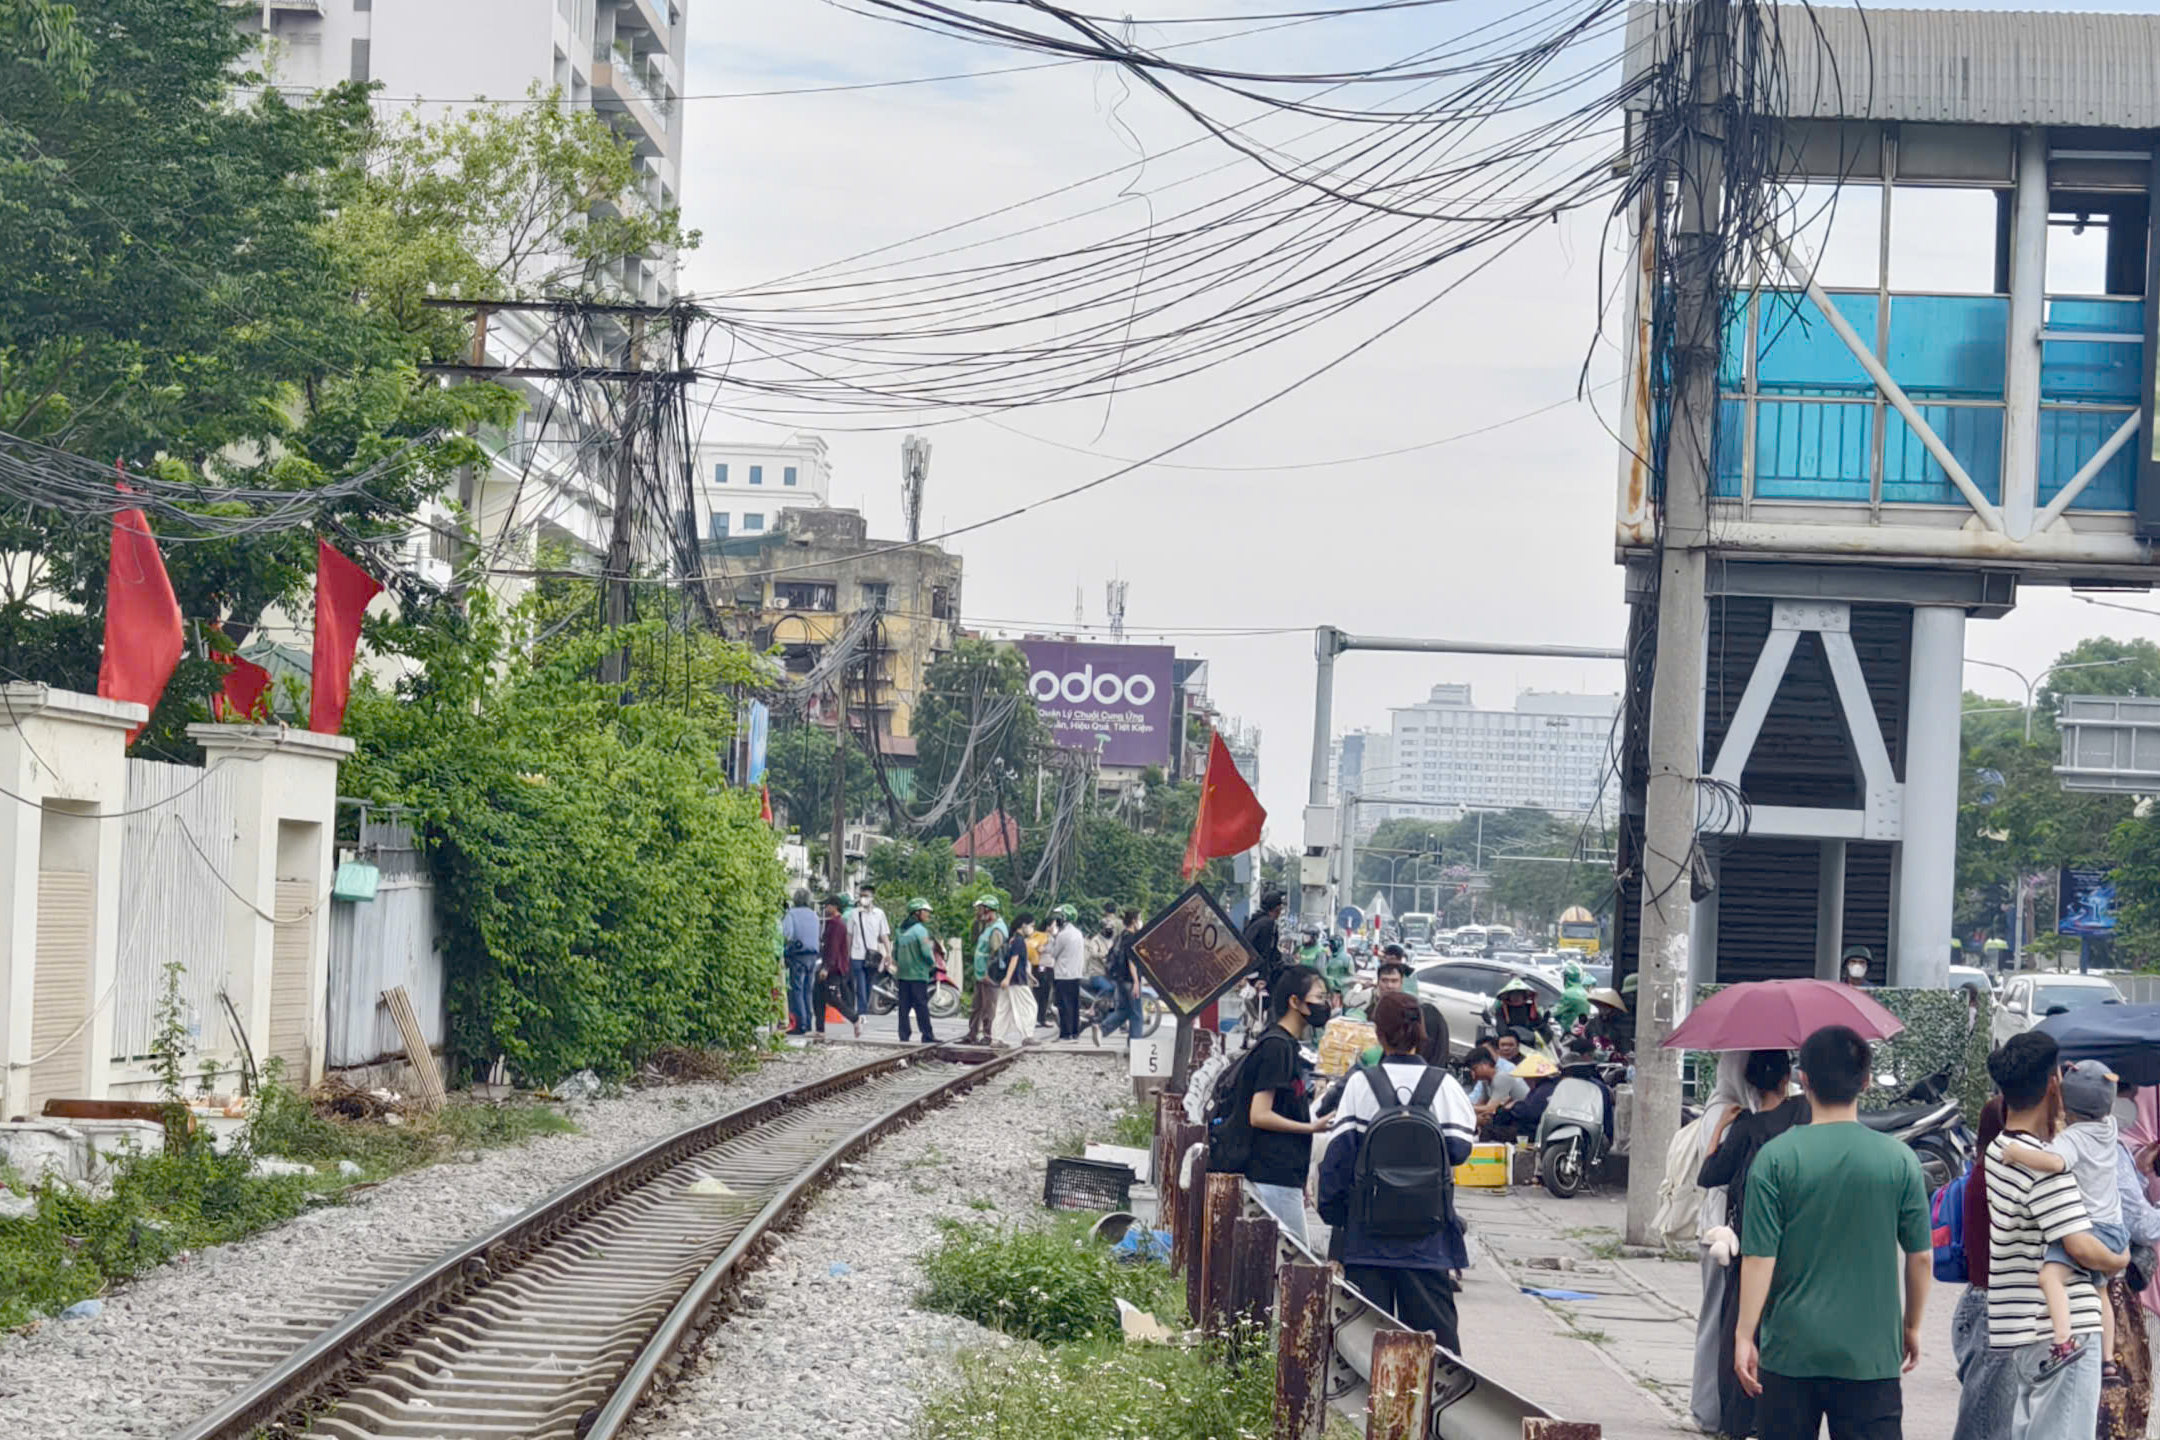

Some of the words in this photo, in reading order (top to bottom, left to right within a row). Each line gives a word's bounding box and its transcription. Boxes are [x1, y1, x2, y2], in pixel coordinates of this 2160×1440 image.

[1029, 664, 1155, 705] odoo
[1062, 709, 1073, 720] Lý
[1100, 710, 1124, 721] Cung
[1150, 1043, 1158, 1056] 2
[1149, 1056, 1158, 1073] 5
